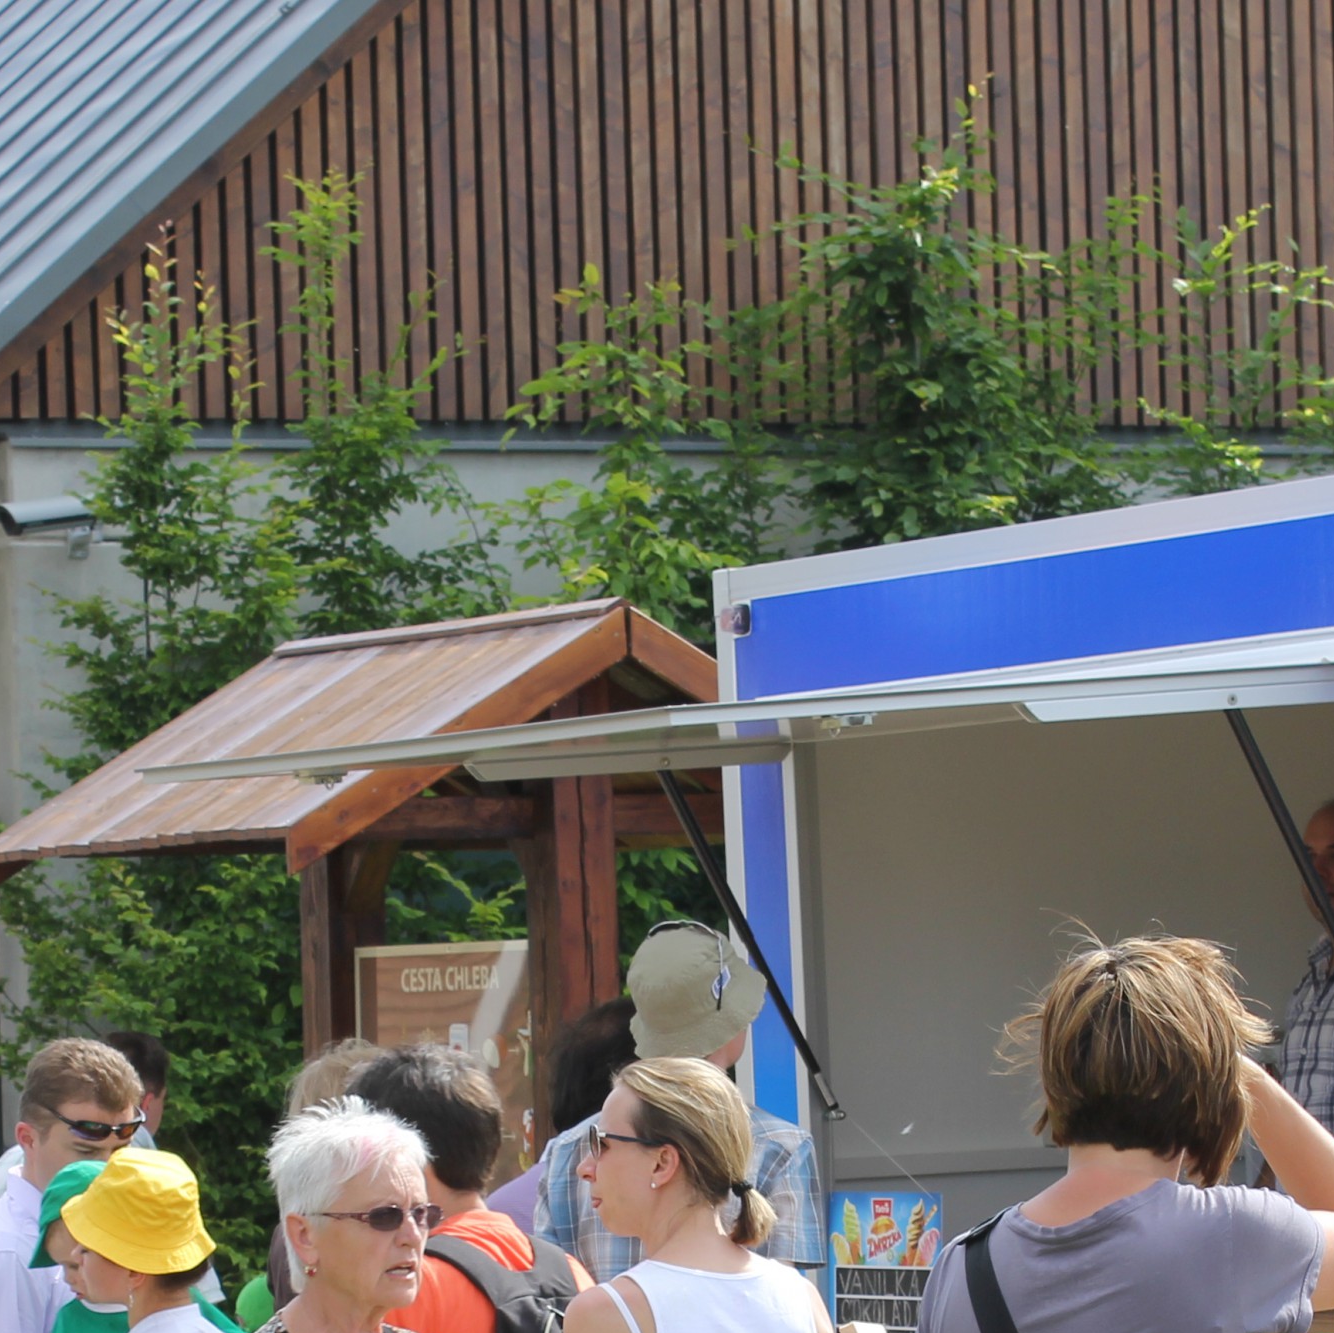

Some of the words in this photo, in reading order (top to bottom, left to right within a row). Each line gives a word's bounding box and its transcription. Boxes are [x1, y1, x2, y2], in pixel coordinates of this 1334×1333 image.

[401, 967, 442, 993] CESTA
[445, 965, 499, 991] CHLEBA
[839, 1269, 920, 1297] VANILKA
